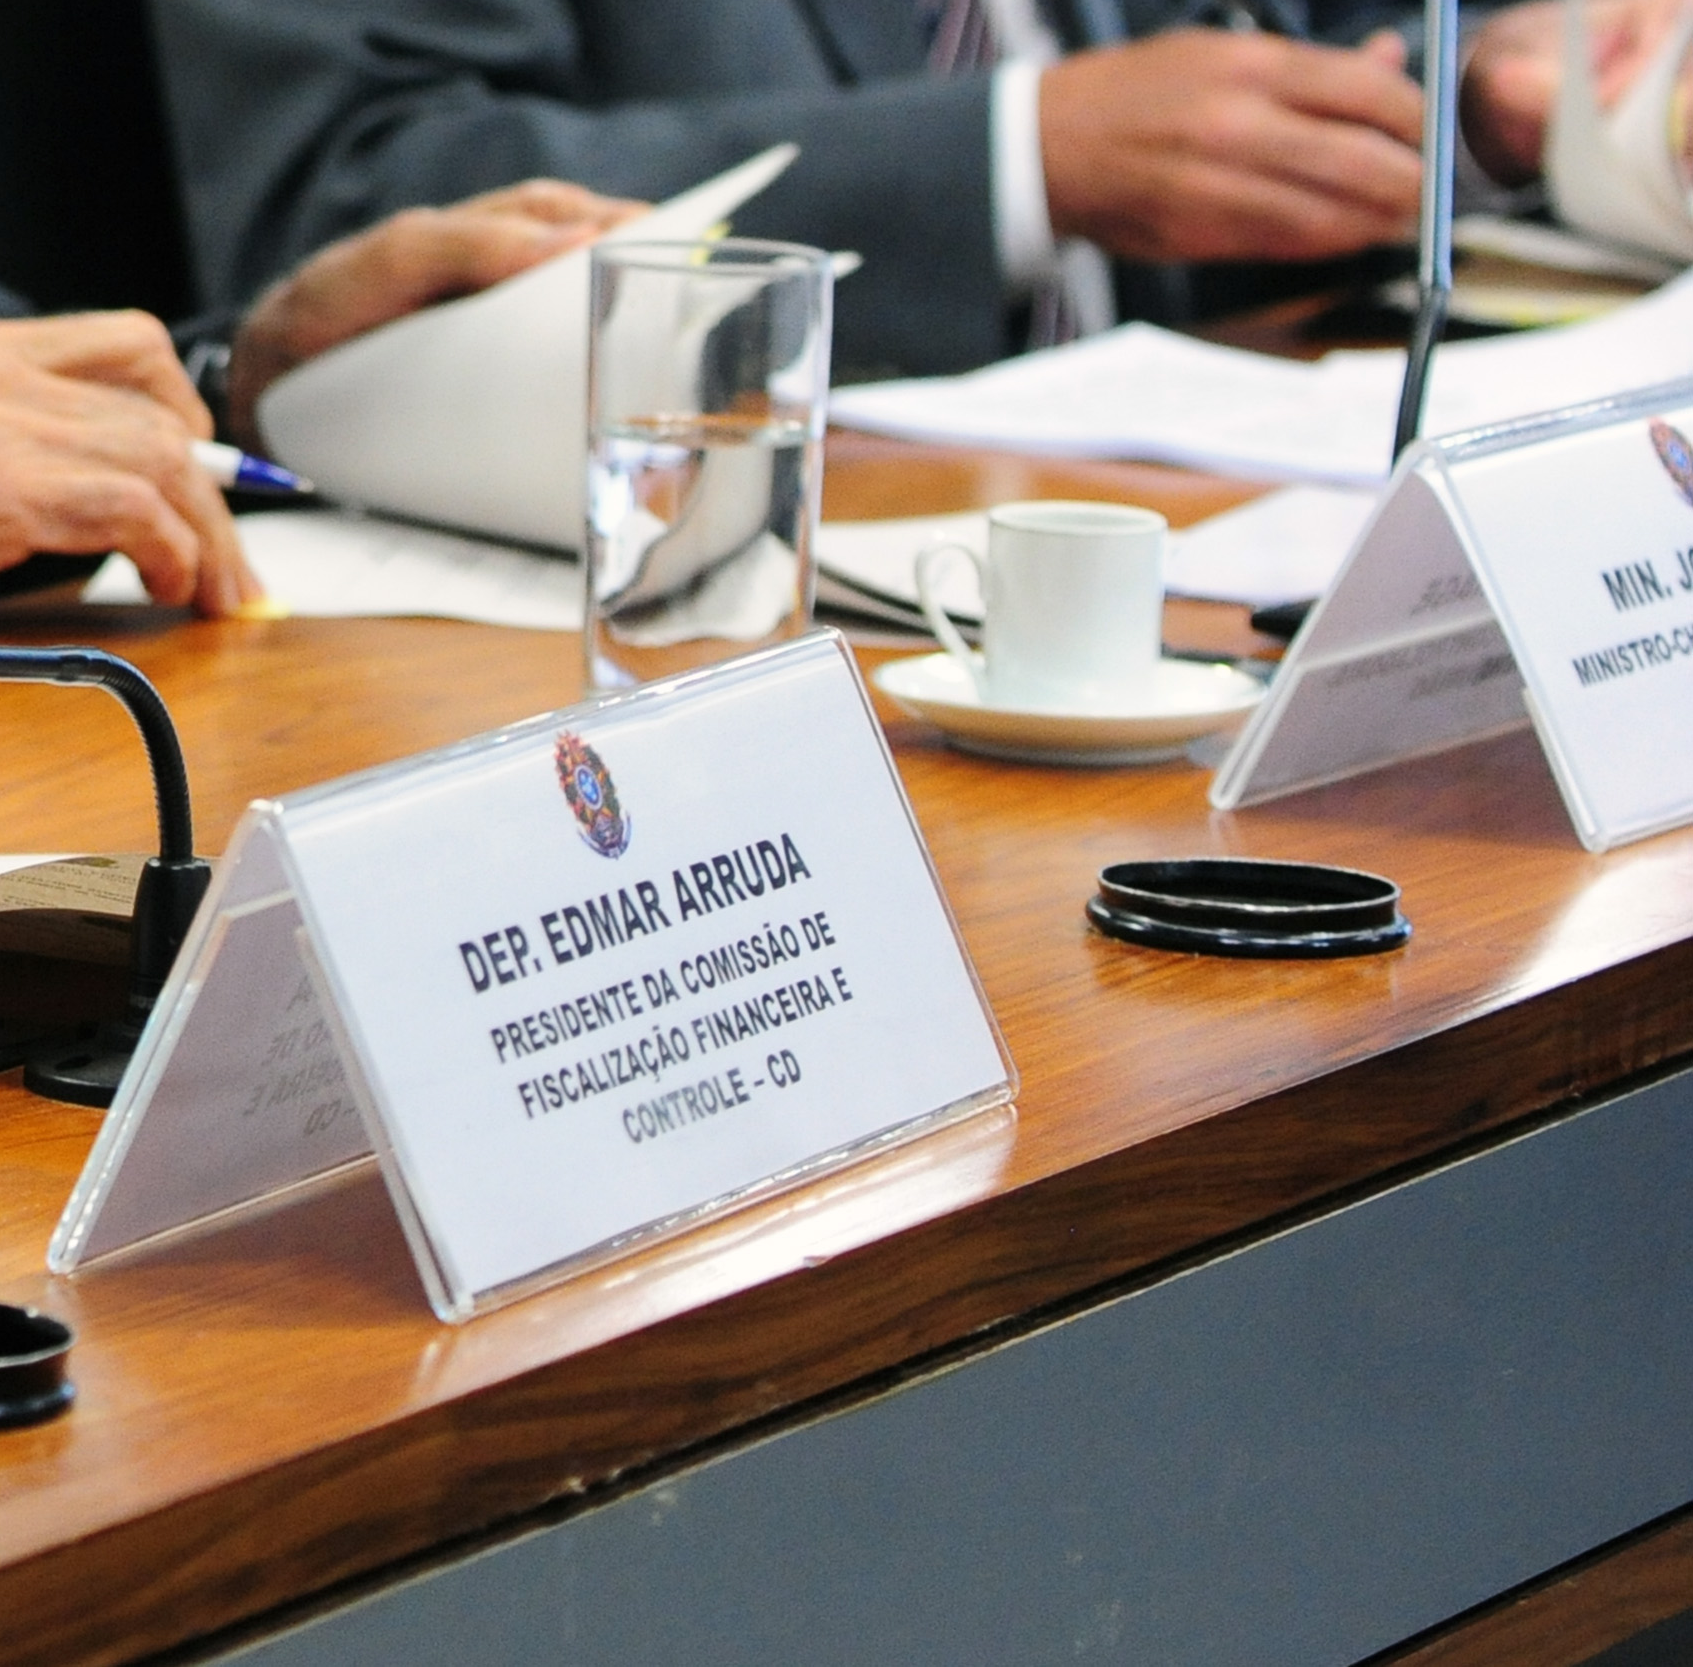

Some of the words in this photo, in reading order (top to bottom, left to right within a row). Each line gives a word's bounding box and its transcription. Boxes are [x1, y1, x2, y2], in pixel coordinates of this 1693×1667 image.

[1601, 560, 1673, 611] MIN.
[1676, 546, 1693, 591] J
[458, 924, 543, 994] DEP.
[539, 880, 671, 965] EDMAR
[672, 832, 813, 922] ARRUDA
[490, 979, 643, 1064] PRESIDENTE
[641, 968, 681, 1008] DA
[679, 922, 801, 995] COMISSÃO
[800, 911, 837, 951] DE
[517, 1025, 690, 1119] FISCALIZAÇÃO
[691, 974, 836, 1054] FINANCEIRA
[831, 967, 854, 1002] E
[622, 1067, 752, 1144] CONTROLE
[766, 1048, 803, 1089] CD
